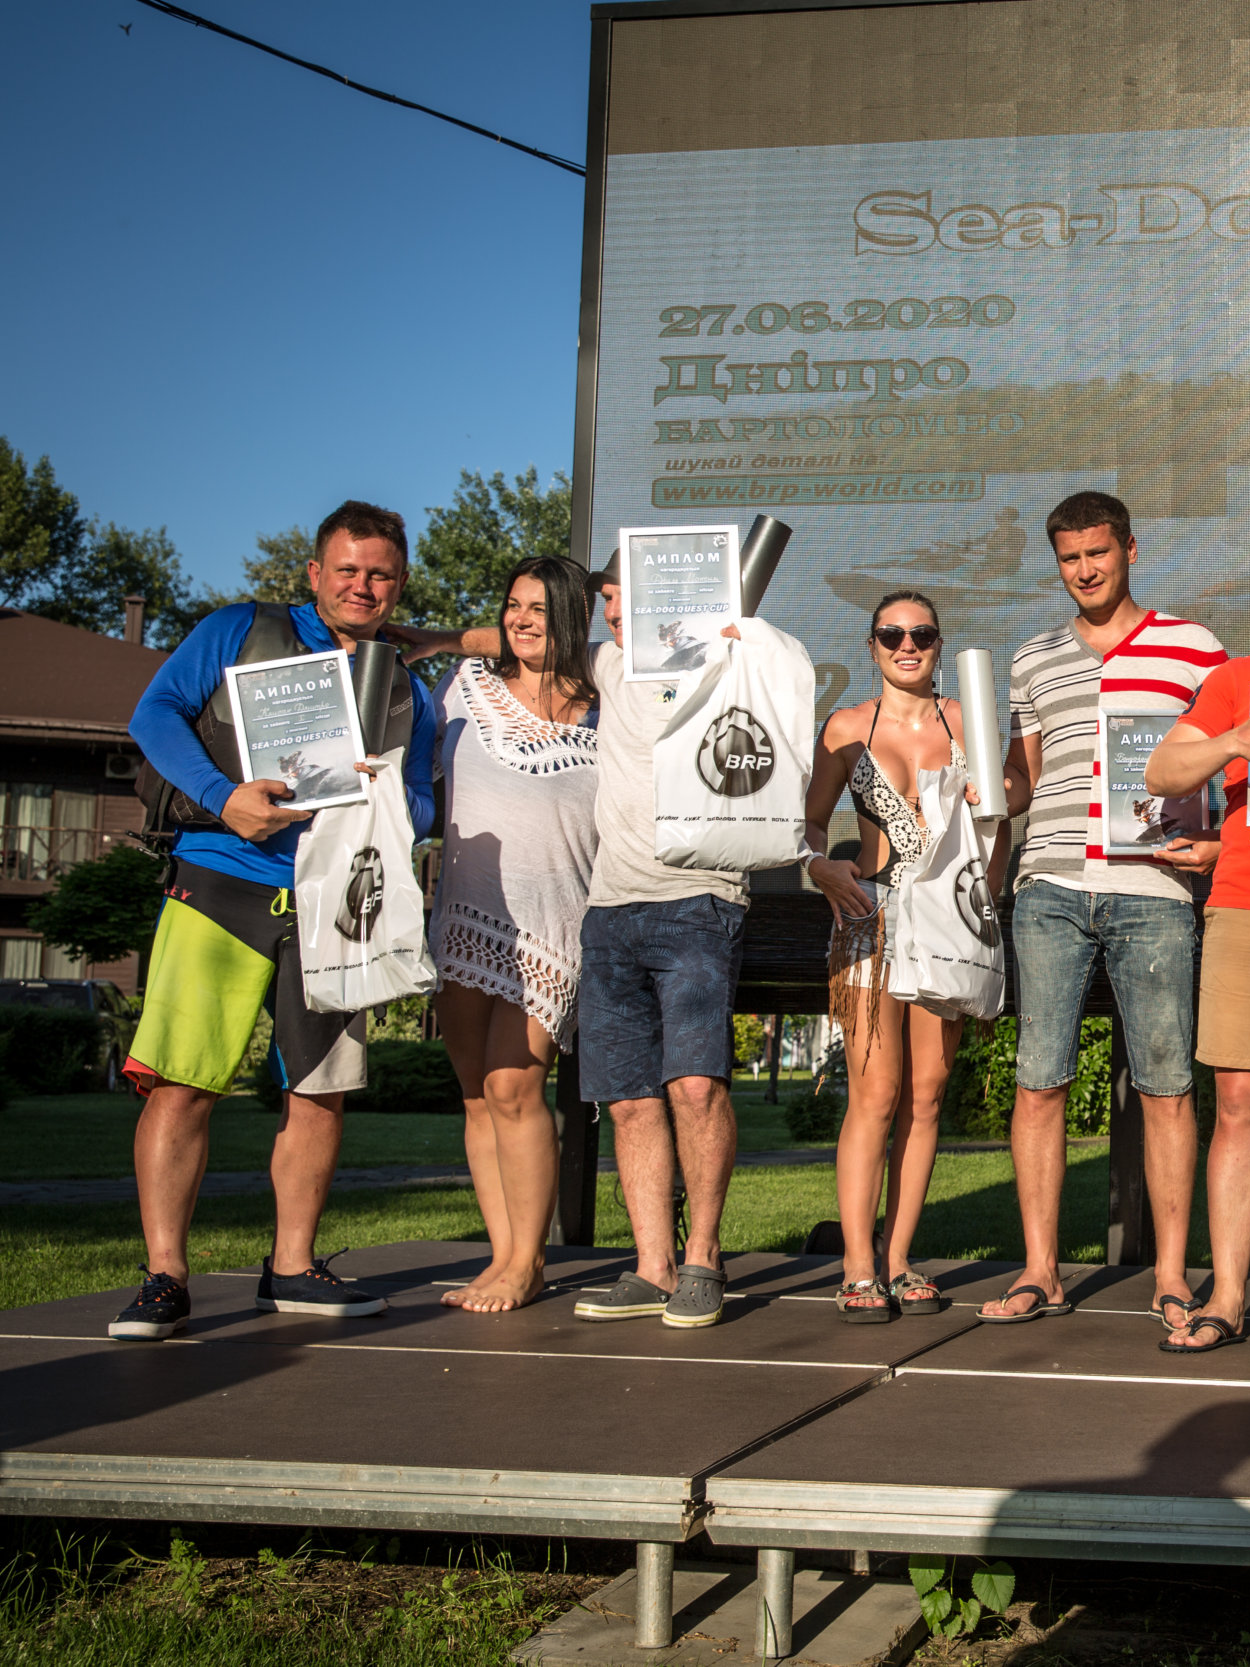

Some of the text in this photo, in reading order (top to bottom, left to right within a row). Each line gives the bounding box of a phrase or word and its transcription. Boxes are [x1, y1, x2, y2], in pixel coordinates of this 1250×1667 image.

[658, 293, 1016, 338] 27.06.2020
[653, 349, 971, 407] Дніпро
[652, 411, 1026, 445] БАРТОЛОМЕО
[664, 455, 743, 473] шукай
[662, 475, 977, 505] www.brp-world.com
[643, 552, 720, 567] ДИПЛОМ
[634, 603, 729, 615] SEA-DOO QUEST CUP
[254, 678, 333, 702] ДИПЛОМ
[251, 737, 294, 751] SEA-DOO
[295, 732, 328, 744] QUEST
[1120, 733, 1164, 745] ДИПЛ
[725, 753, 772, 771] BRP
